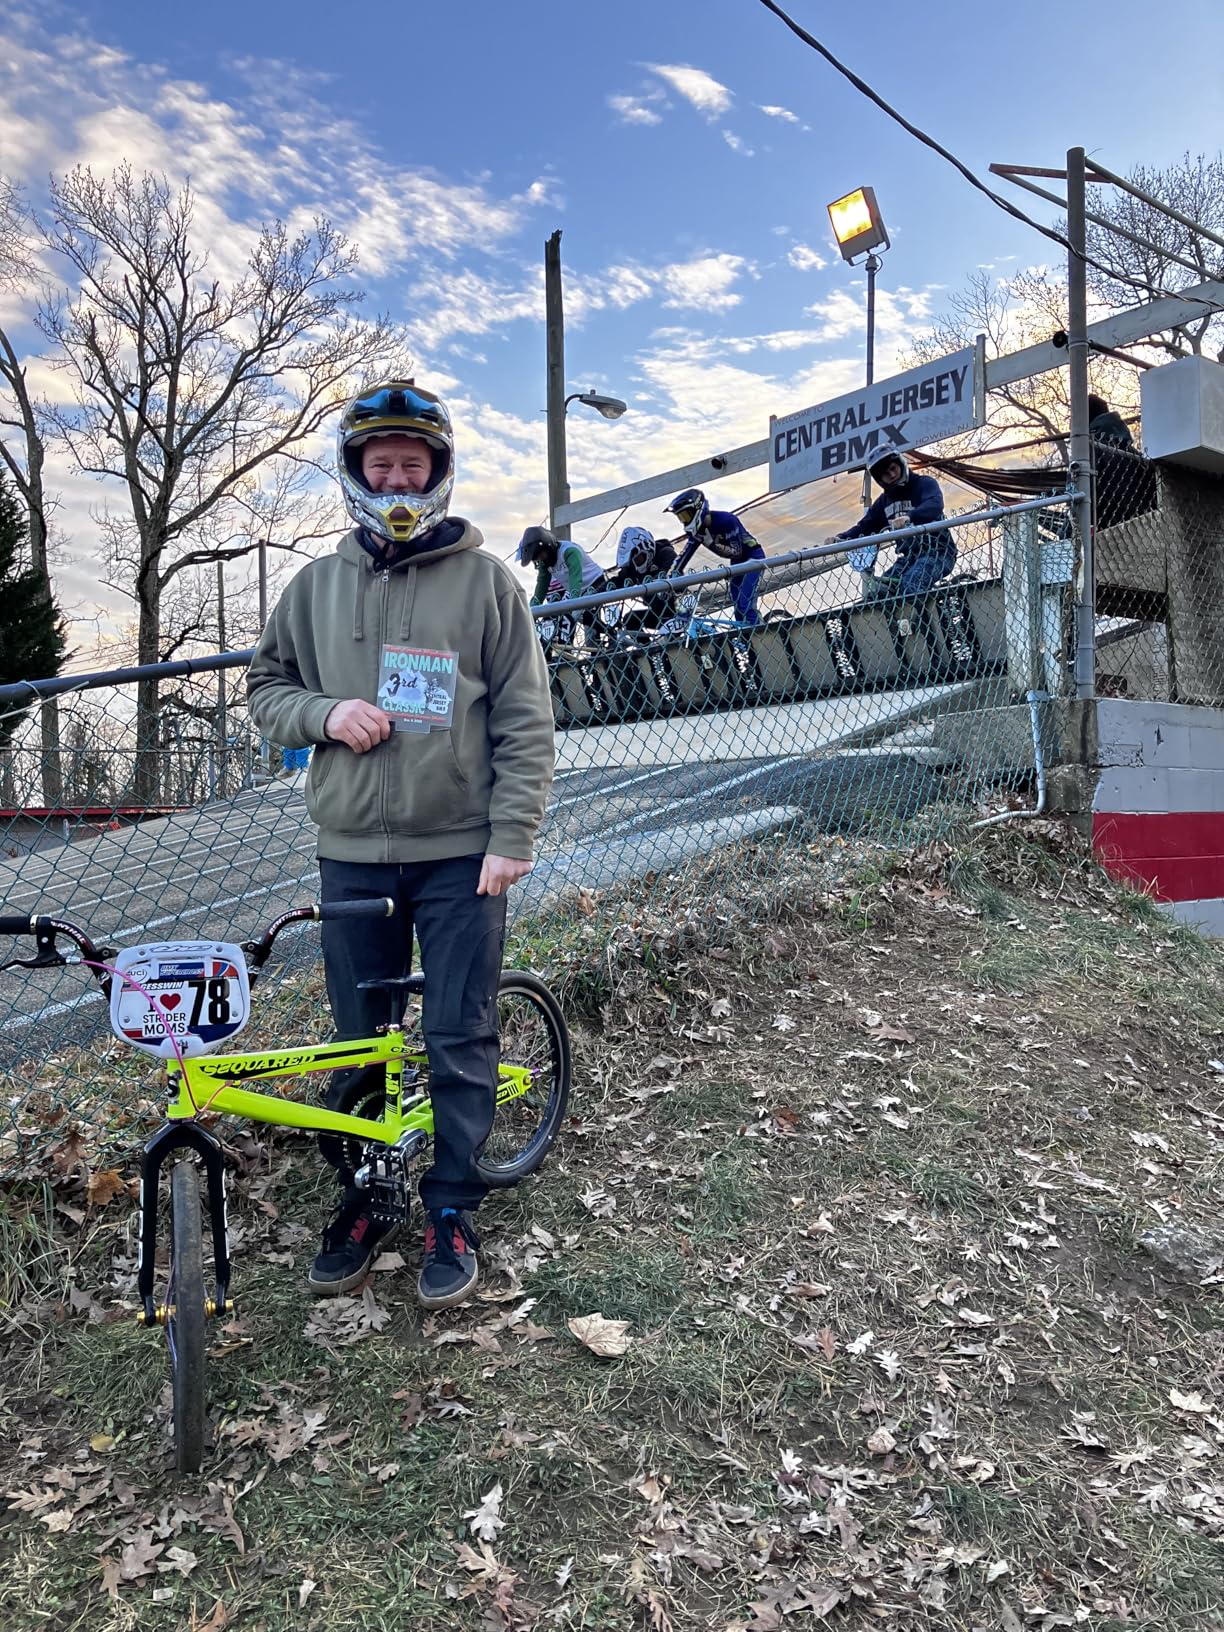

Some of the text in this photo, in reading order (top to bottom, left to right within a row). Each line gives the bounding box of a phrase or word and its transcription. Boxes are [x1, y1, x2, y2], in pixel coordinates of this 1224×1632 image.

[774, 365, 968, 465] CENTRAL JERSEY
[821, 418, 911, 472] BMX
[384, 651, 454, 674] IRONMAN
[387, 673, 418, 697] 3rd
[382, 697, 426, 715] CLASSIC
[188, 979, 230, 1027] 78
[142, 1012, 186, 1024] STRDER
[144, 1023, 185, 1035] MOMS
